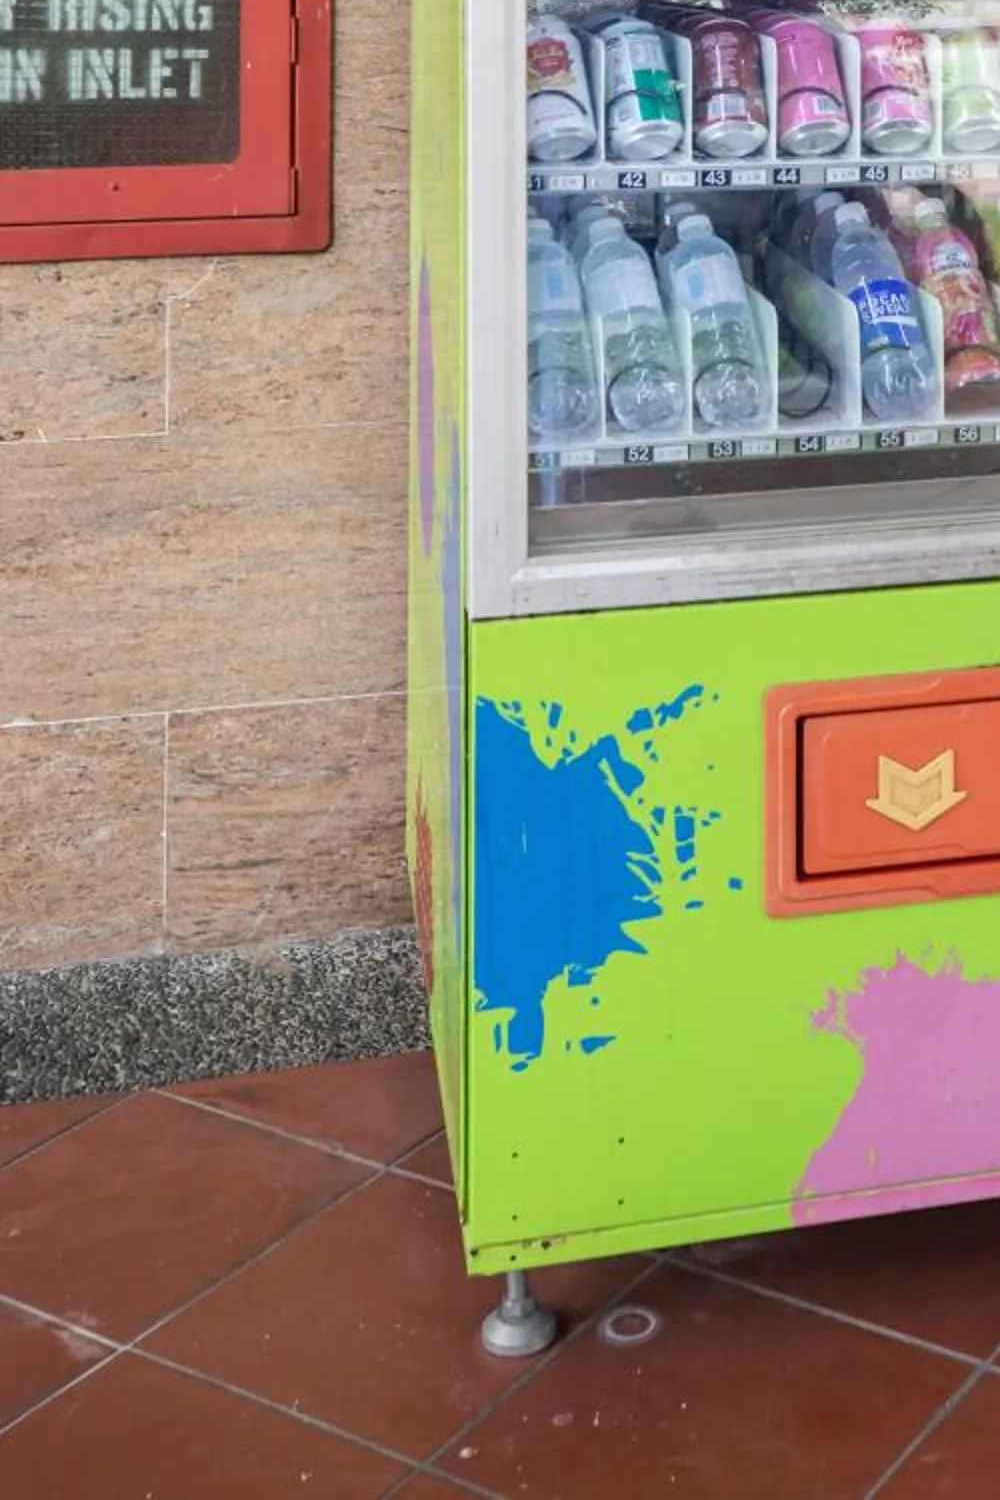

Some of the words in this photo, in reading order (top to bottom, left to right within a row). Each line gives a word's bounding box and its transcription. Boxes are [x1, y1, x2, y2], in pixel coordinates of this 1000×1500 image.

[65, 48, 209, 100] INLET
[621, 173, 644, 188] 42
[705, 170, 727, 185] 43
[776, 168, 797, 184] 44
[865, 166, 887, 181] 45
[880, 432, 900, 447] 55
[959, 426, 977, 442] 56
[713, 442, 733, 457] 53
[800, 436, 819, 451] 54
[629, 447, 649, 462] 52
